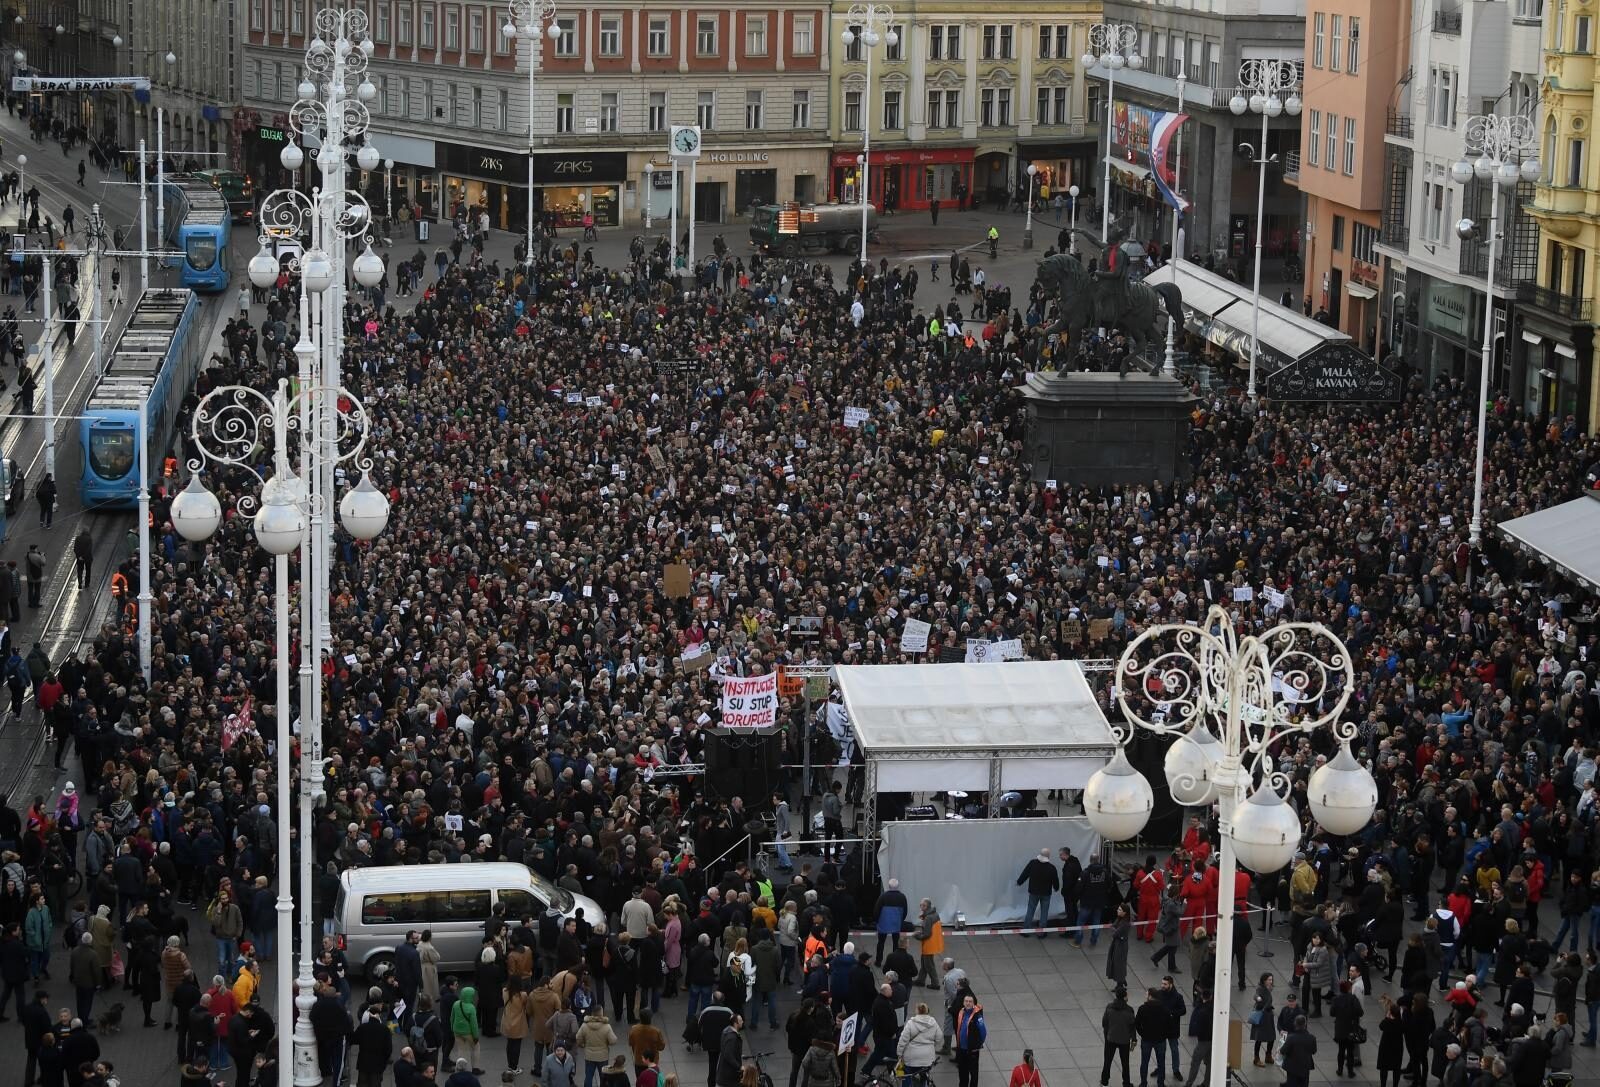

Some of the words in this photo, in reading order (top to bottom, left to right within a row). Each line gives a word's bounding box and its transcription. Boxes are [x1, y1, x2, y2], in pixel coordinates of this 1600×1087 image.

[41, 82, 70, 90] BRAT
[76, 82, 113, 90] BRATU
[261, 129, 283, 141] DOUGLAS
[711, 152, 769, 163] HOLDING
[480, 156, 502, 172] ZAKS
[553, 161, 592, 173] ZAKS
[1322, 367, 1352, 377] MALA
[1316, 378, 1358, 388] KAVANA
[729, 698, 744, 710] SU
[750, 695, 772, 710] STUP
